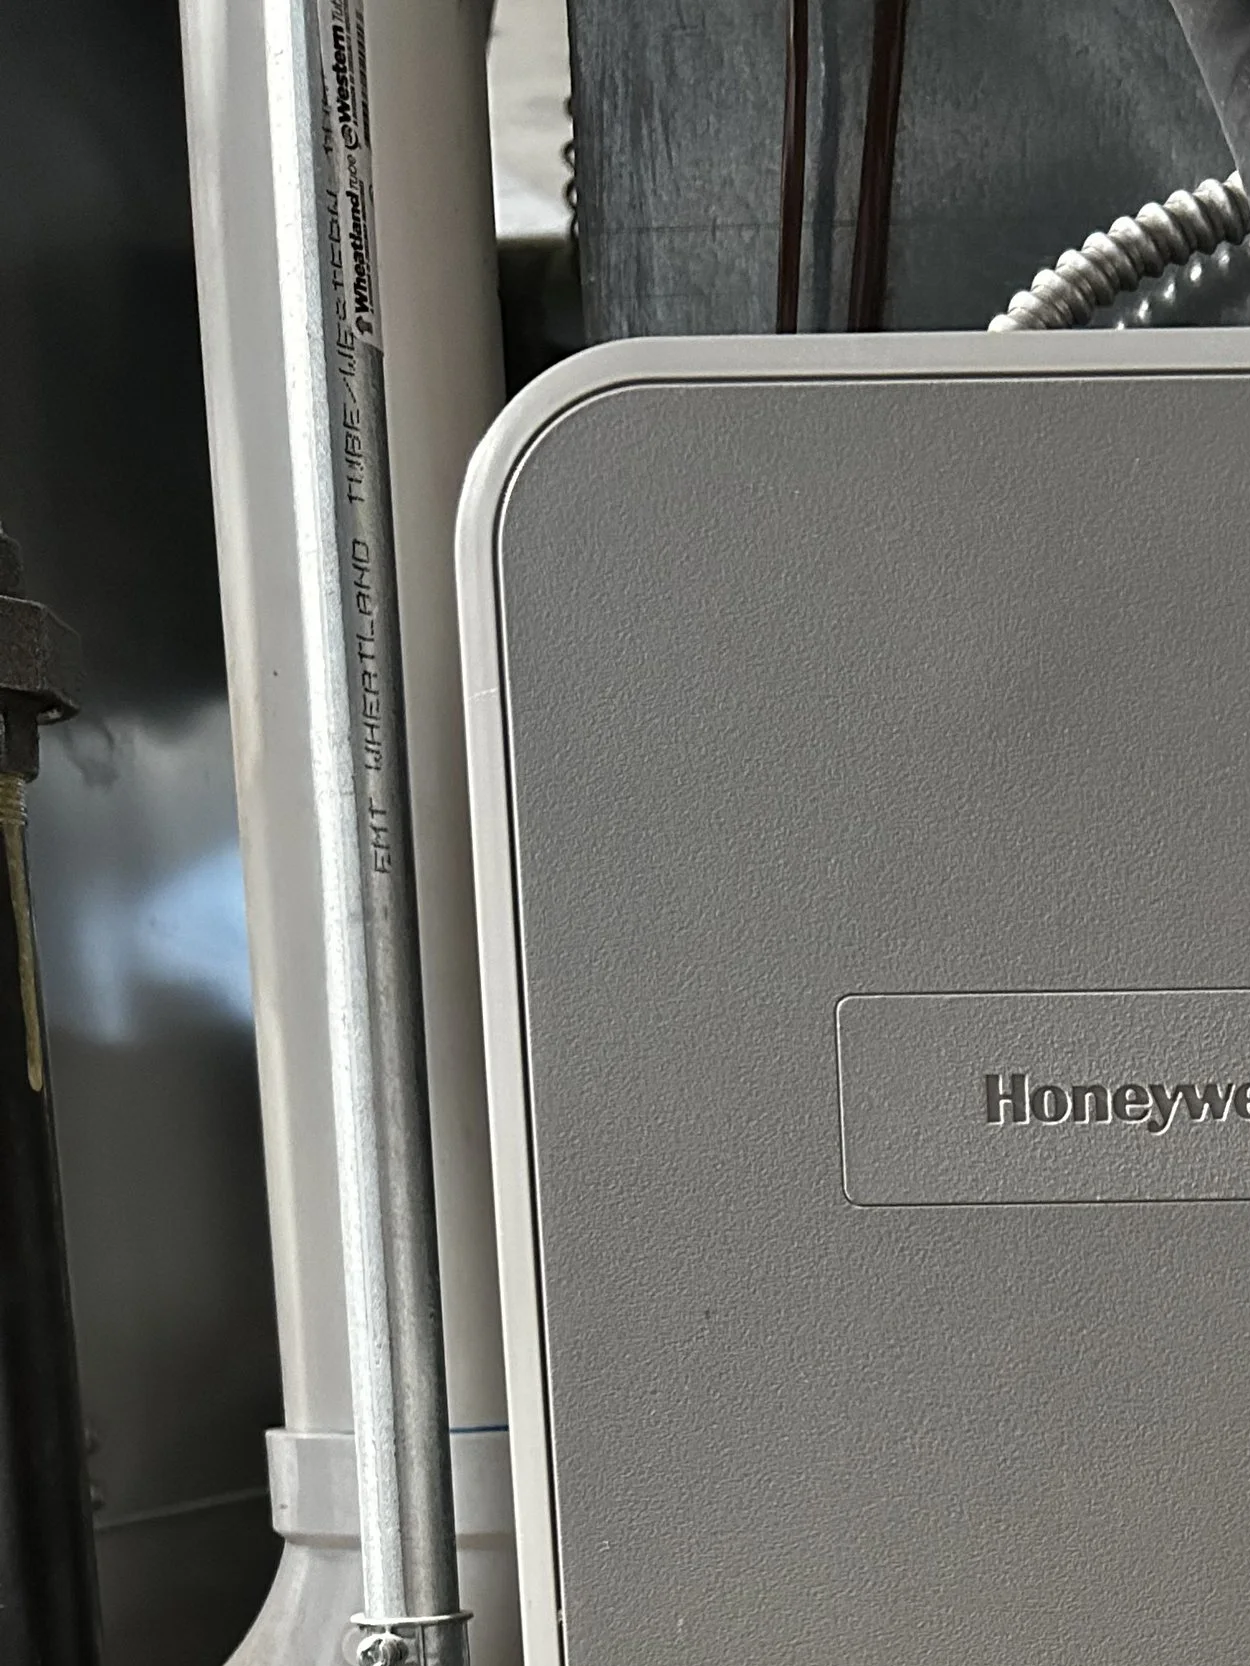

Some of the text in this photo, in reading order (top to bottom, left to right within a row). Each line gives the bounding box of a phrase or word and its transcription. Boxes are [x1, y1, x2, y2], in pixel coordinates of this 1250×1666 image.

[332, 24, 352, 123] Western
[345, 190, 370, 314] Wheatland
[352, 539, 383, 772] WHEATLAND
[368, 796, 393, 875] EMT
